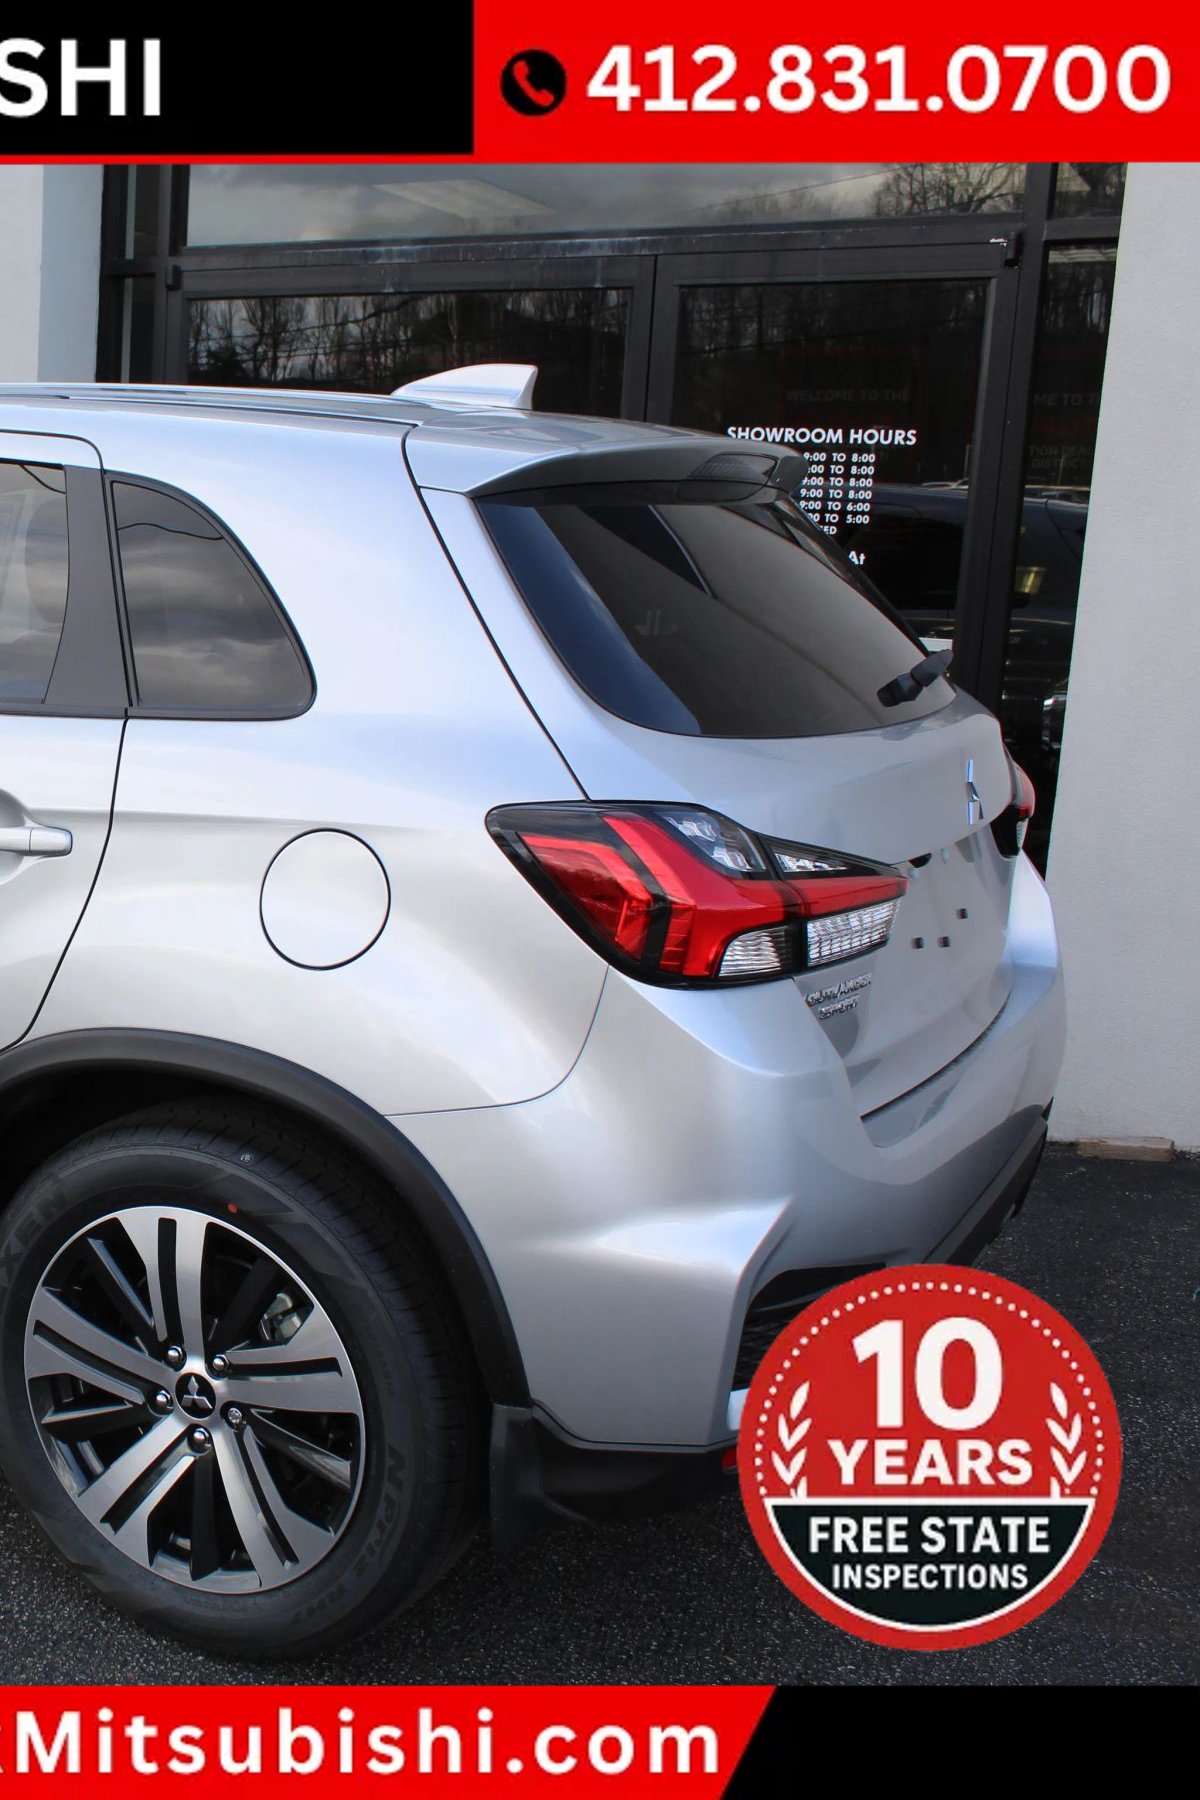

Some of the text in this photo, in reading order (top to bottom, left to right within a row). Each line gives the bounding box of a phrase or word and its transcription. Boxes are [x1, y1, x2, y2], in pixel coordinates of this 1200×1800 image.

[727, 426, 917, 446] SHOWROOM HOURS
[803, 452, 876, 464] 9:00 TO 8:00
[807, 464, 875, 476] :00 TO 8:00
[828, 477, 844, 487] TO
[849, 477, 874, 488] 8:00
[799, 488, 873, 500] 9:00 TO 8:00
[826, 501, 842, 511] TO
[846, 502, 871, 512] 6:00
[824, 513, 839, 523] TO
[845, 514, 870, 524] 5:00
